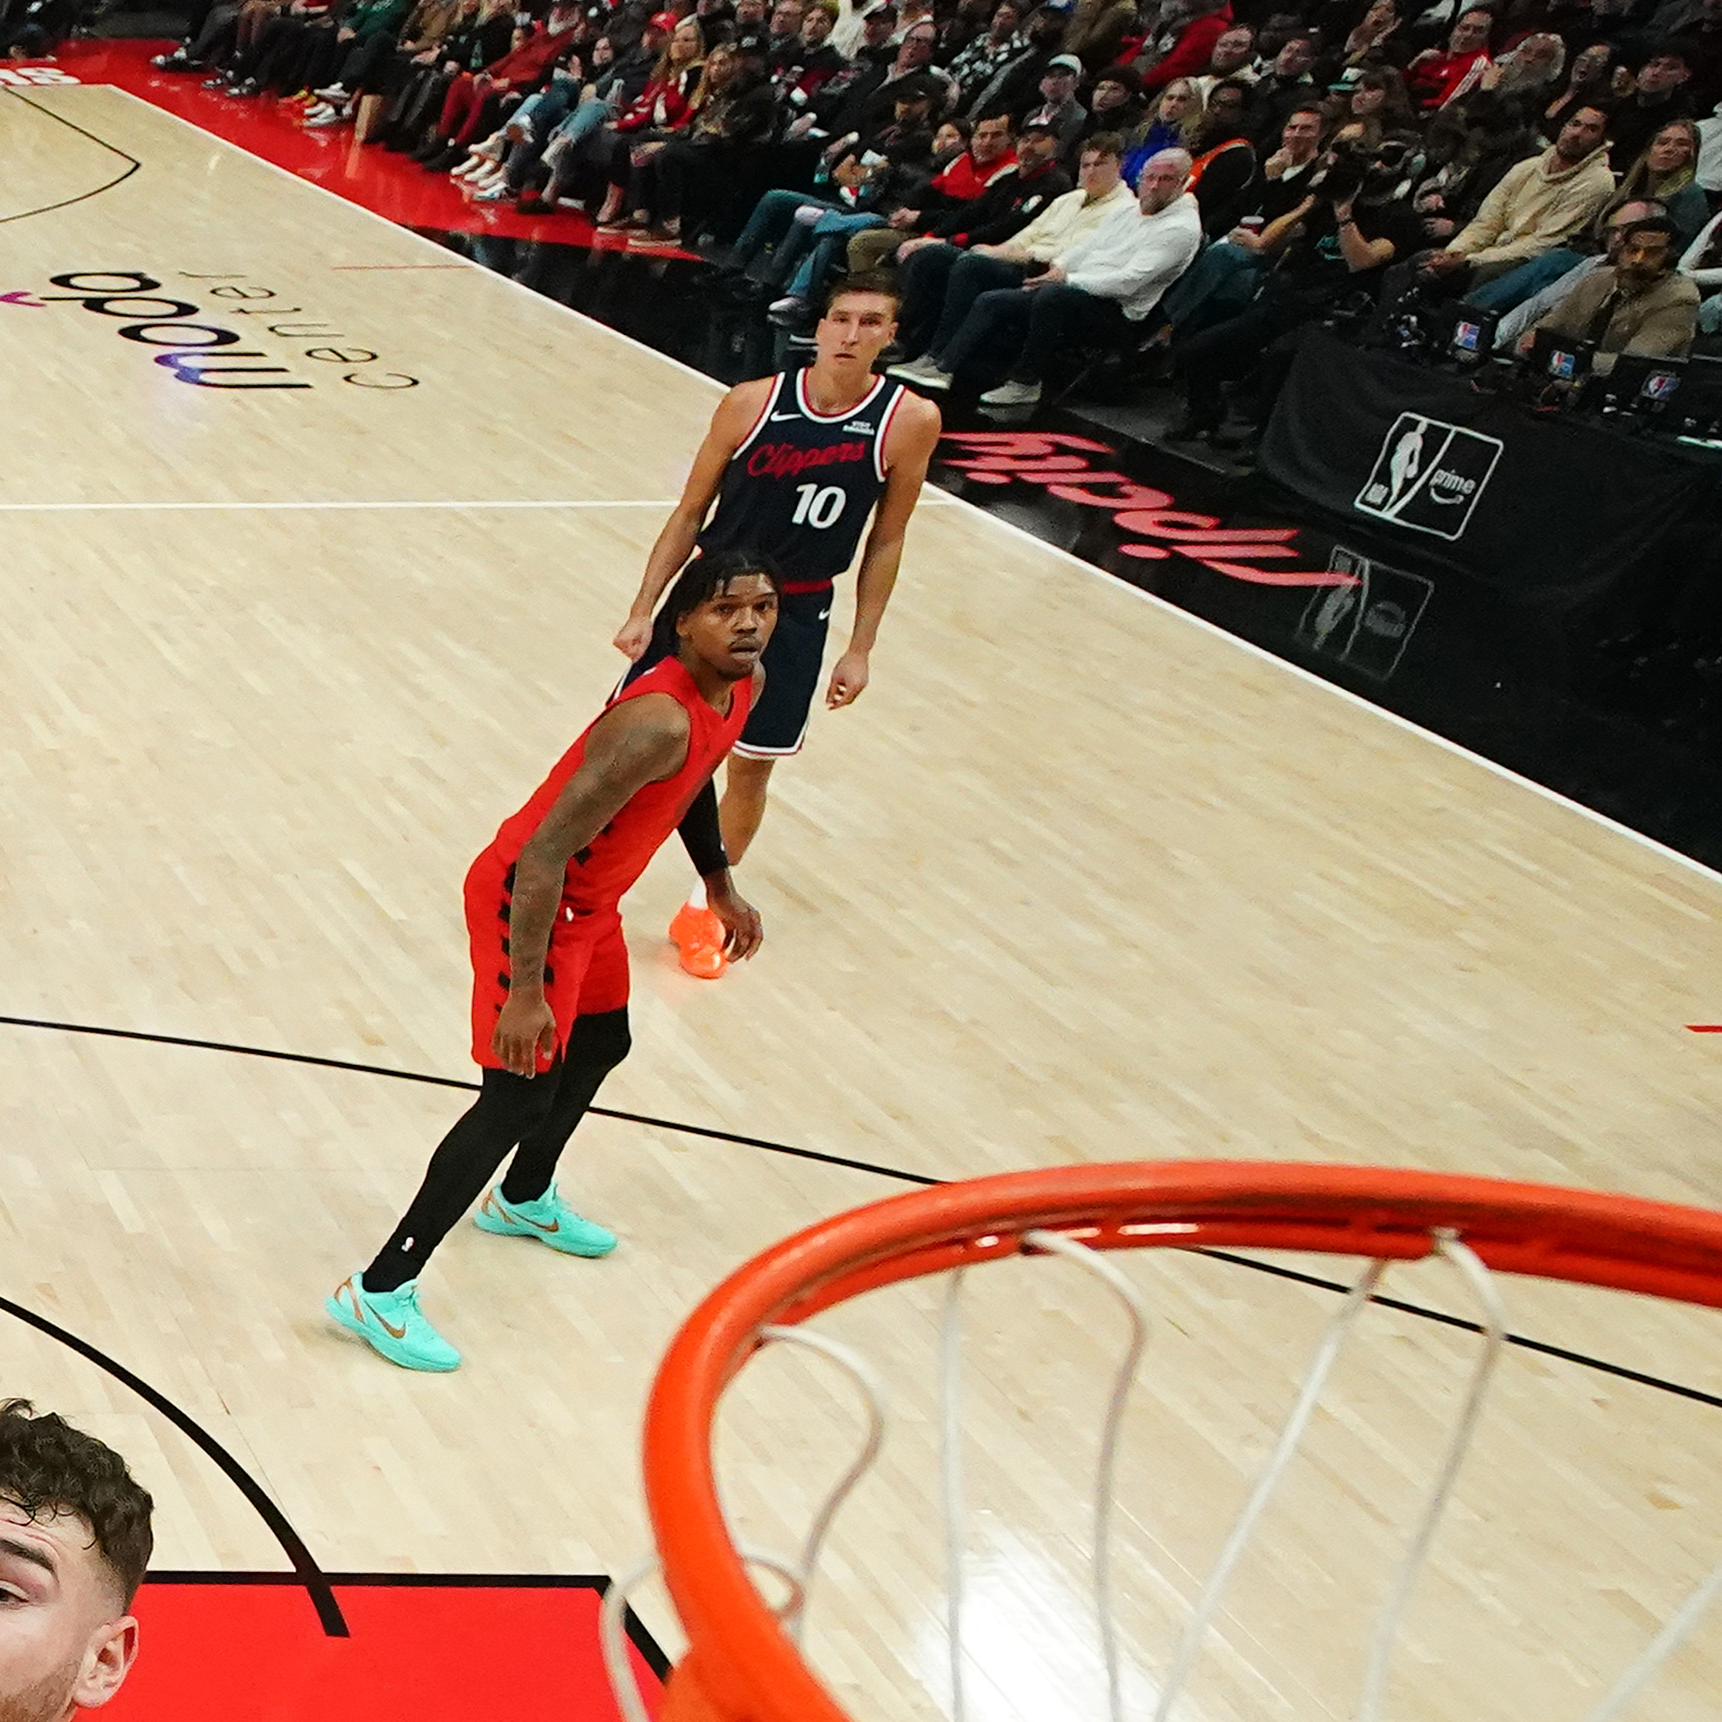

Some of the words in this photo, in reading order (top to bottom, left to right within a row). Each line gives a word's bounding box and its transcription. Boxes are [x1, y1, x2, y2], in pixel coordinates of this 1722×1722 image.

[39, 271, 313, 389] moda
[178, 271, 420, 389] center
[791, 483, 847, 529] 10
